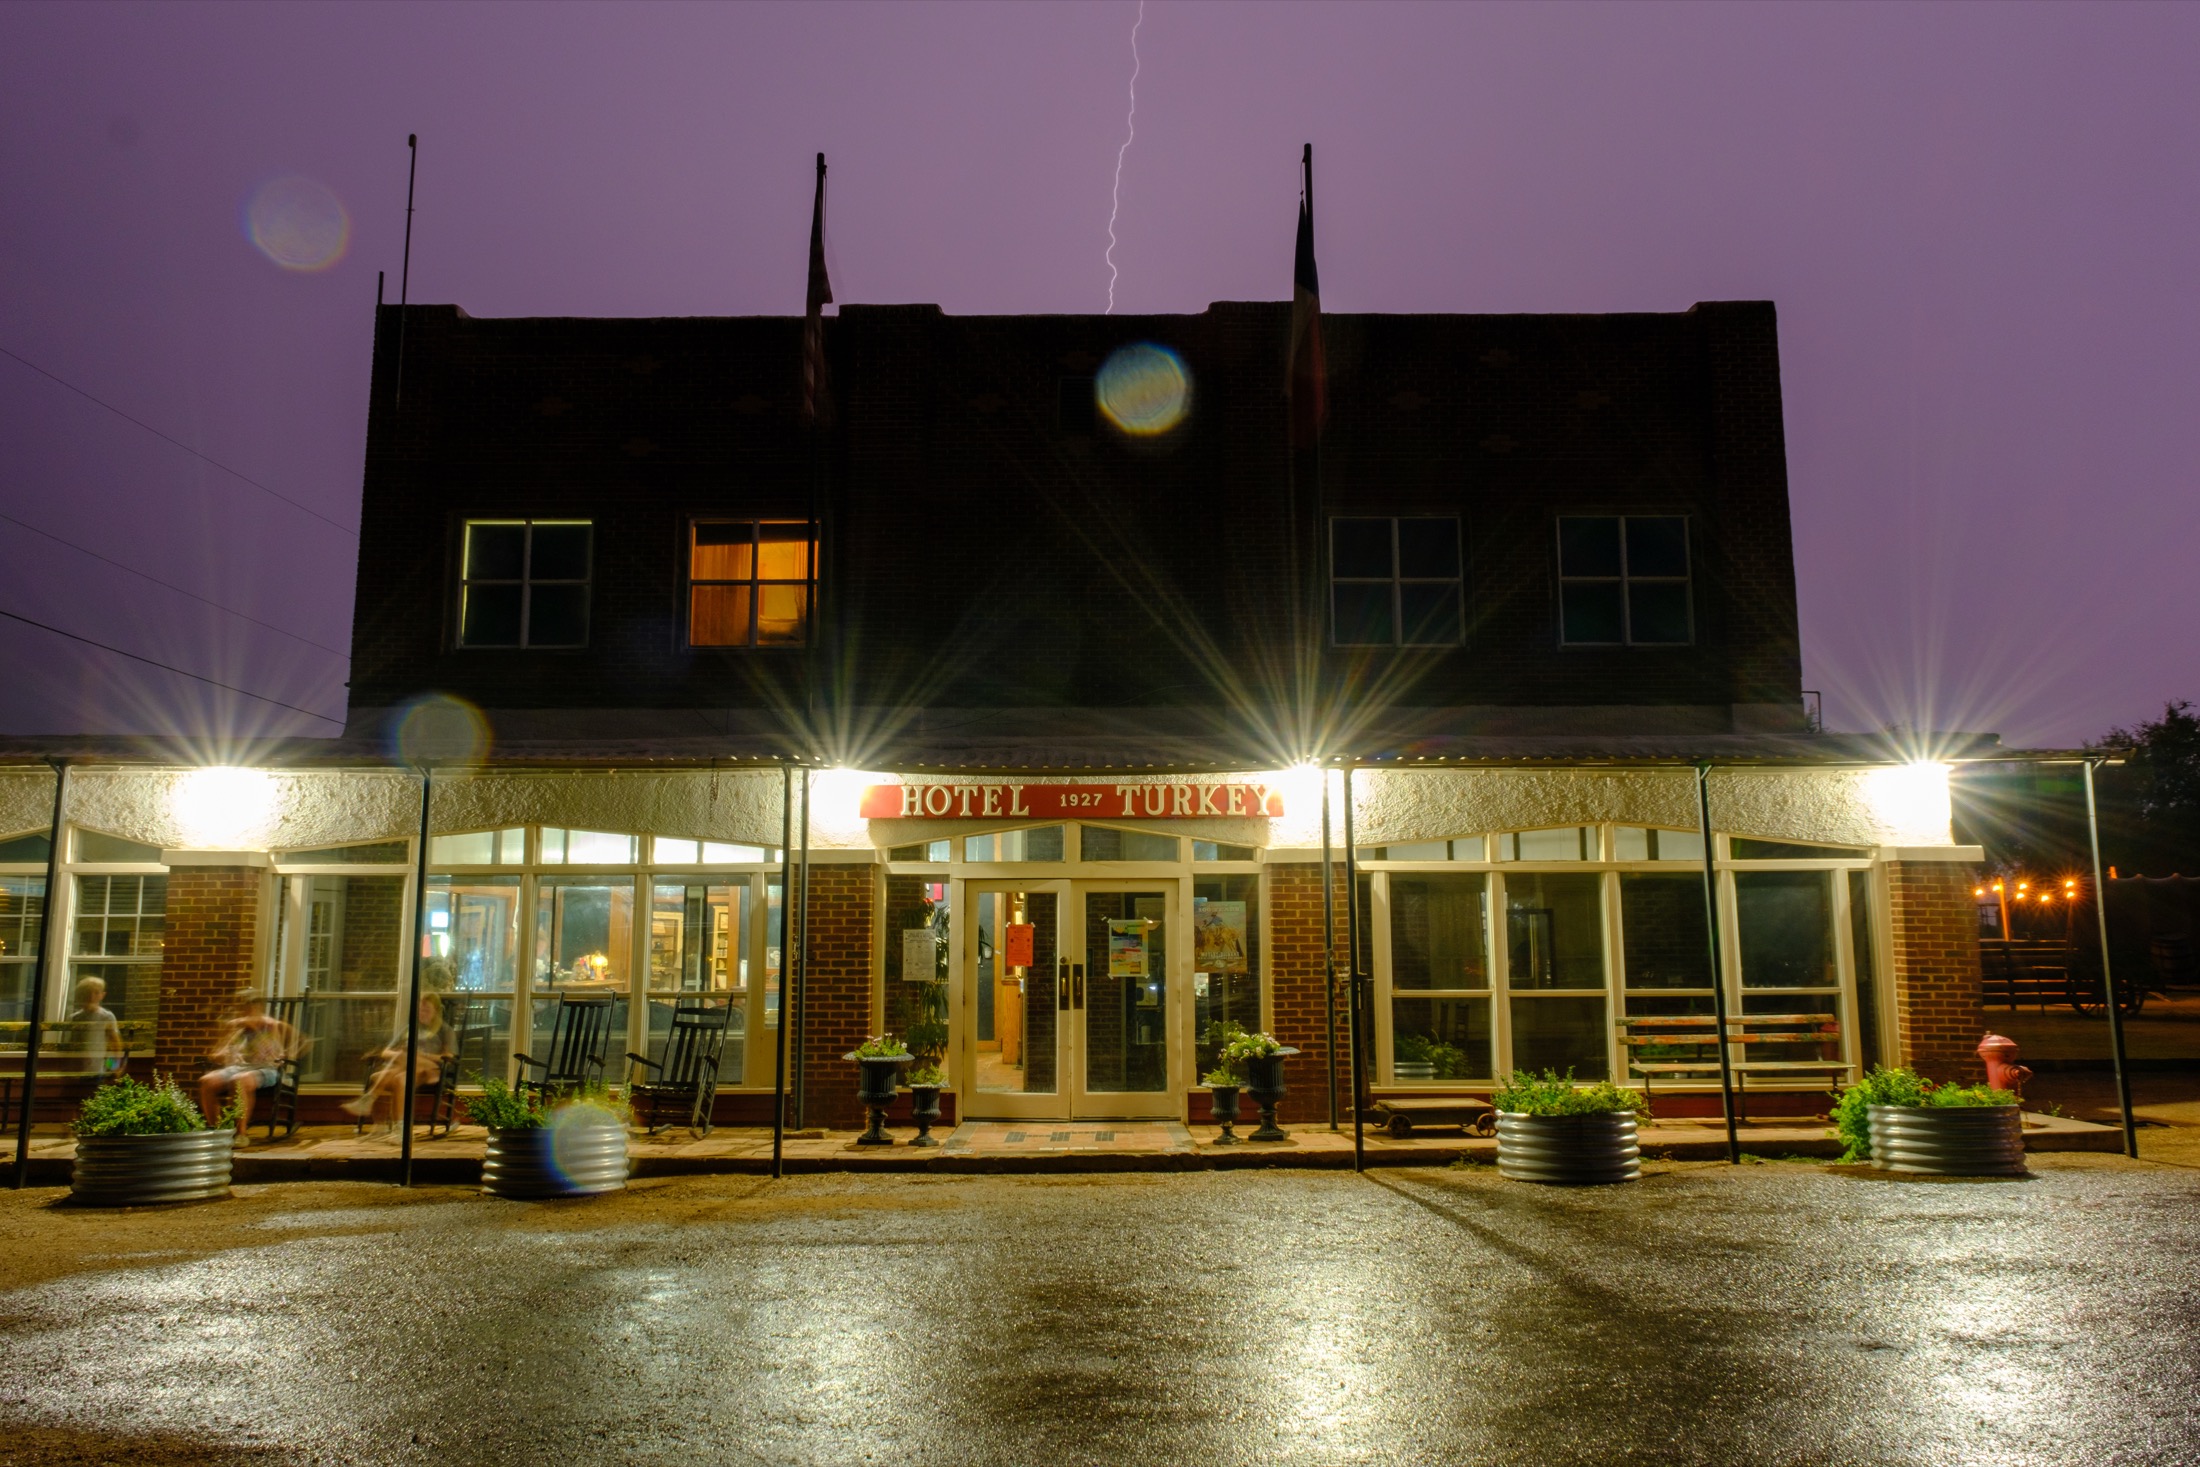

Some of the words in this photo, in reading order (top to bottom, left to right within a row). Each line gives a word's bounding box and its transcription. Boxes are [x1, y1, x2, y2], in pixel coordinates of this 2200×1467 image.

[900, 785, 1029, 816] HOTEL
[1060, 793, 1103, 807] 1927
[1116, 784, 1275, 816] TURKEY
